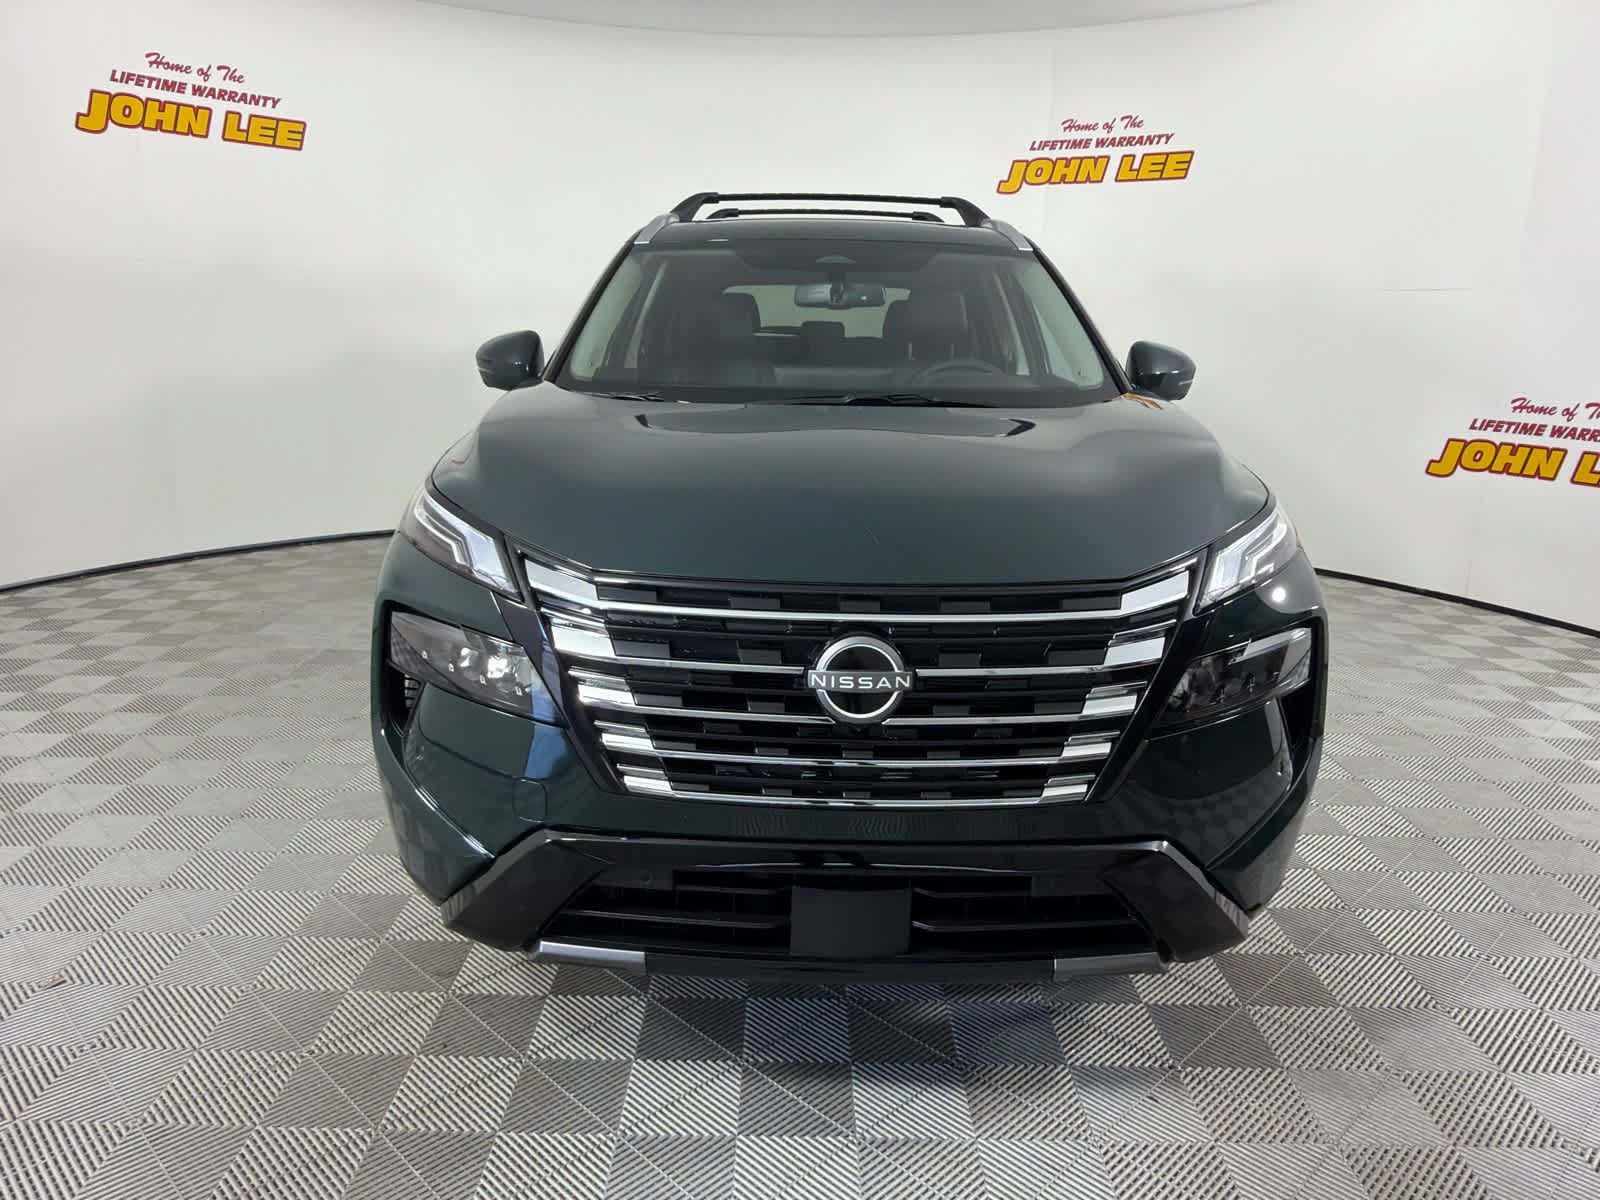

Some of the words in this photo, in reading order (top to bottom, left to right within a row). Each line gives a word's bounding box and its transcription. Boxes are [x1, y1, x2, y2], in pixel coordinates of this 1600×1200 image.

[145, 52, 192, 74] Home
[196, 64, 212, 82] of
[216, 65, 245, 84] The
[110, 69, 188, 94] LIFETIME
[191, 82, 281, 109] WARRANTY
[75, 89, 213, 138] JOHN
[221, 109, 307, 151] LEE
[1061, 118, 1099, 133] Home
[1102, 117, 1117, 134] of
[1120, 114, 1144, 130] The
[1029, 137, 1092, 151] LIFETIME
[1094, 132, 1176, 149] WARRANTY
[996, 155, 1111, 195] JOHN
[1114, 150, 1195, 182] LEE
[1510, 397, 1558, 417] Home
[1561, 403, 1580, 422] of
[1469, 418, 1548, 437] LIFETIME
[1425, 438, 1568, 481] JOHN
[811, 674, 910, 689] NISSAN
